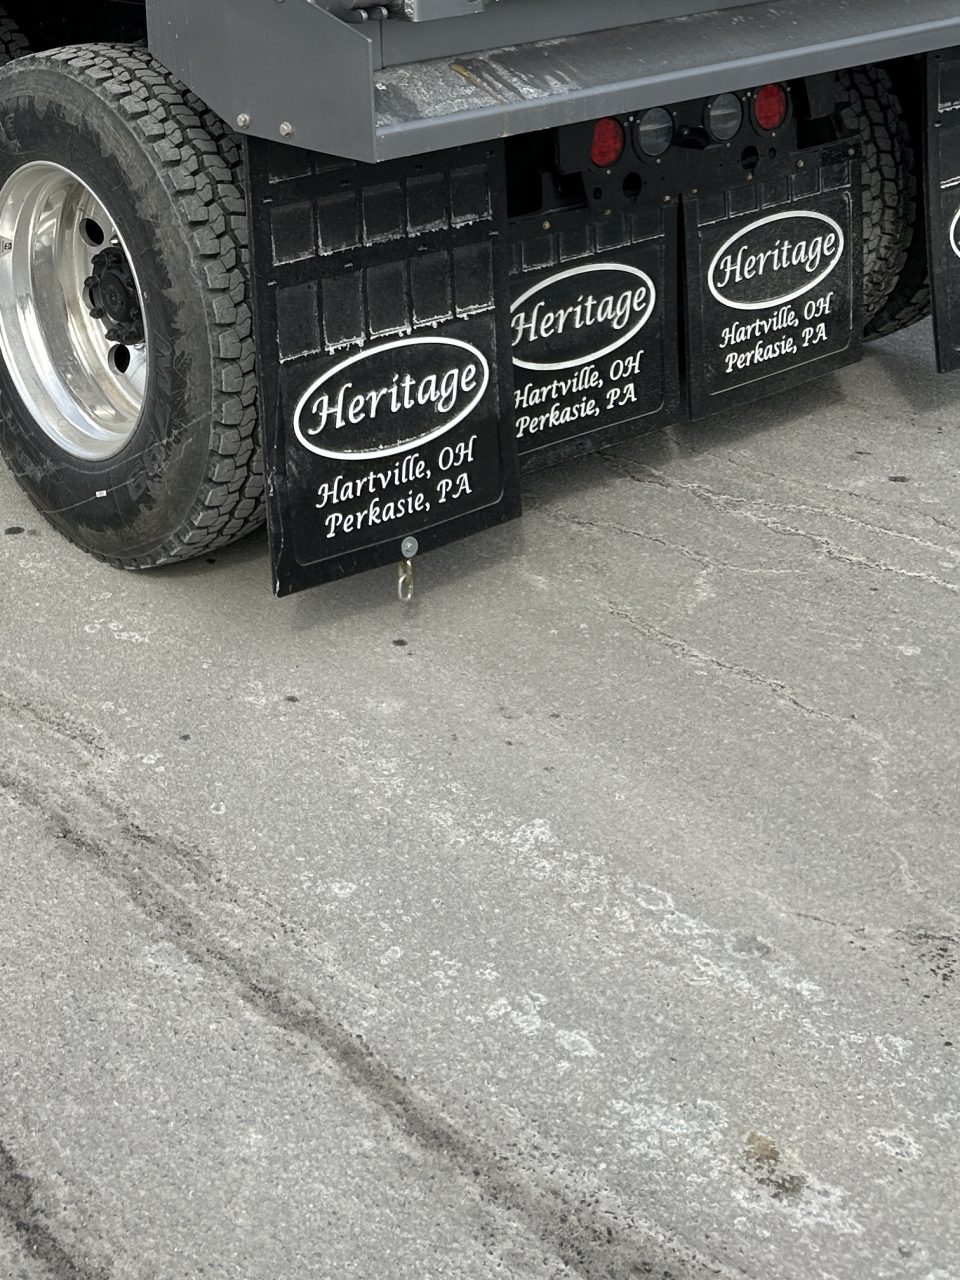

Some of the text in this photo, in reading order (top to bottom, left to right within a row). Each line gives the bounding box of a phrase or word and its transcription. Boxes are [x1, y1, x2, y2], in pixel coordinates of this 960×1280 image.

[716, 233, 836, 288] Heritage
[510, 286, 647, 346] Heritage
[719, 292, 833, 348] Hartville, OH
[725, 322, 828, 373] Perkasie, PA
[307, 364, 477, 435] Heritage
[514, 350, 644, 409] Hartville, OH
[515, 382, 637, 438] Perkasie, PA
[315, 435, 477, 508] Hartville, OH
[324, 472, 472, 538] Perkasie, PA
